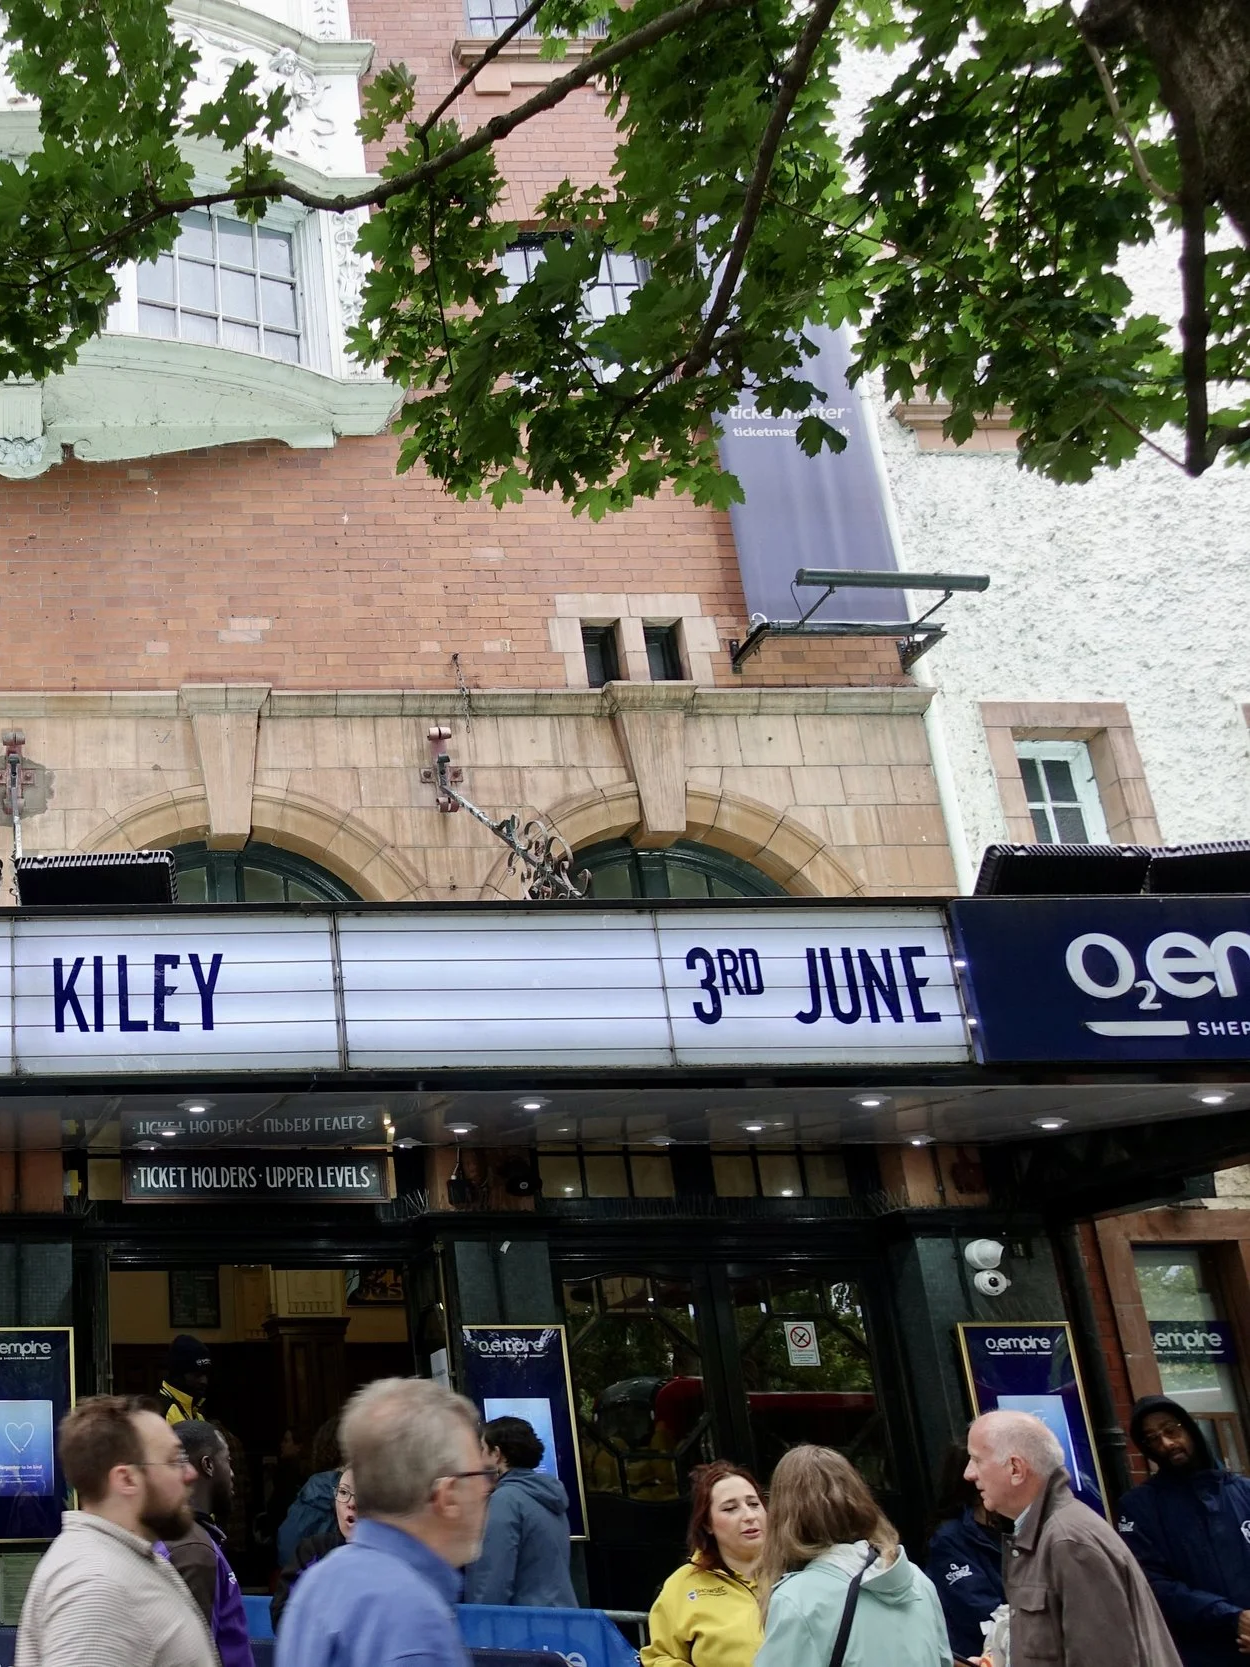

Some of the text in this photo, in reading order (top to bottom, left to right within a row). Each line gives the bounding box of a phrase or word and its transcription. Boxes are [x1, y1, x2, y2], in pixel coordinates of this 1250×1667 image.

[730, 404, 846, 420] tickemaster
[53, 953, 223, 1033] KILEY
[685, 946, 942, 1025] 3RD JUNE
[138, 1165, 370, 1188] TICKET HOLDERS UPPER LEVELS
